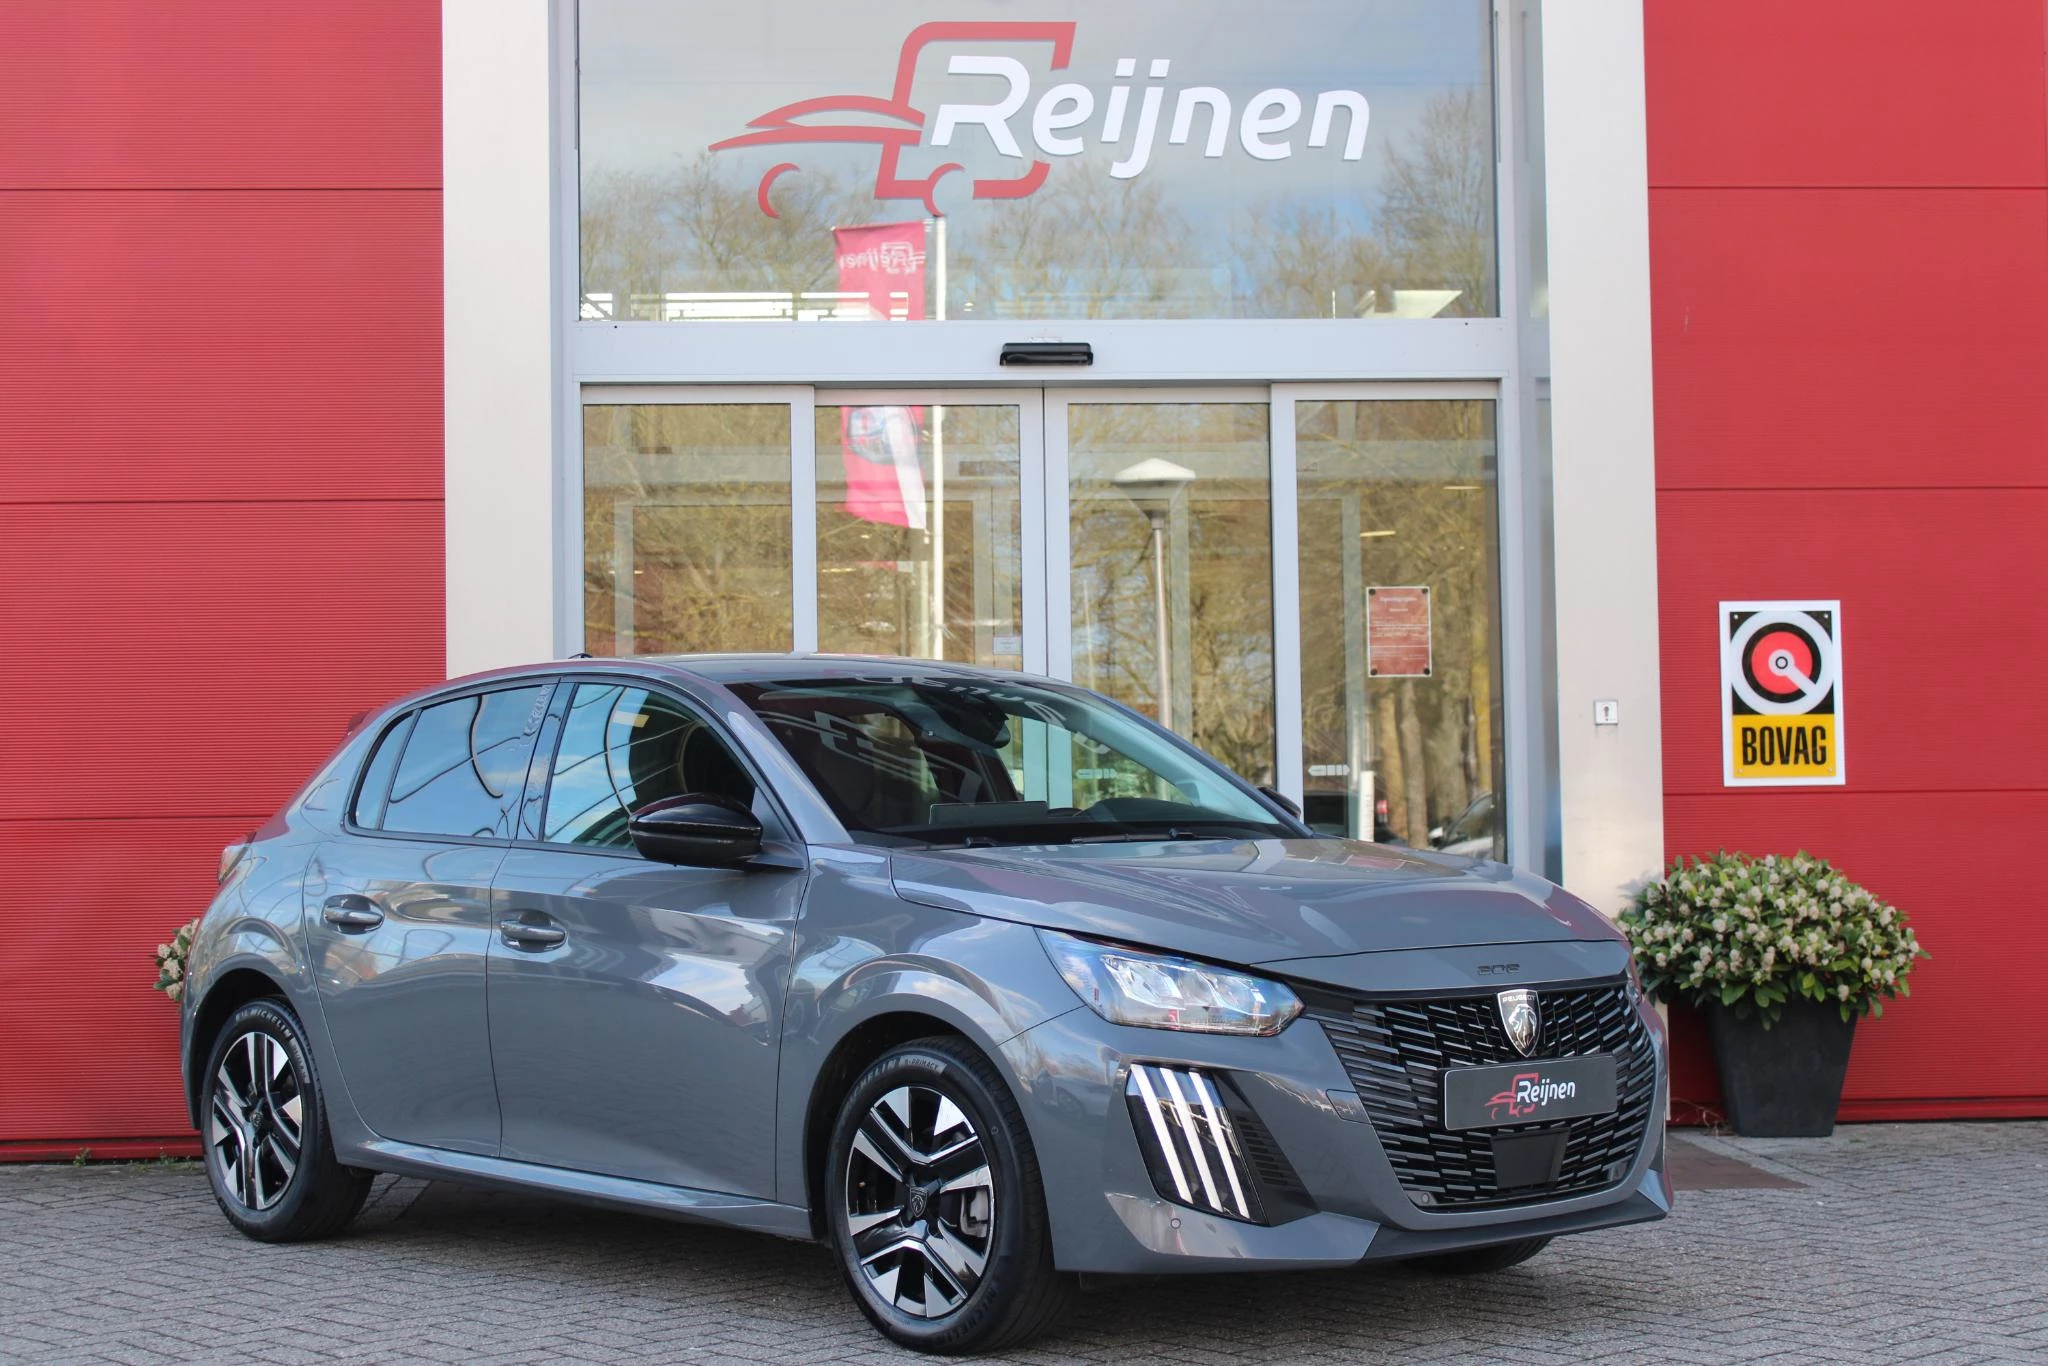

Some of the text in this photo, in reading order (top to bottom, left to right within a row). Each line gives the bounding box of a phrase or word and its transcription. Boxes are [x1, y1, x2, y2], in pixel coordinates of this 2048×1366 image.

[930, 55, 1370, 179] Reijnen
[1741, 726, 1827, 766] BOVAG
[1502, 994, 1537, 1003] PEUGEOT
[250, 1008, 292, 1038] MICHELIN
[1516, 1078, 1576, 1106] Reijnen
